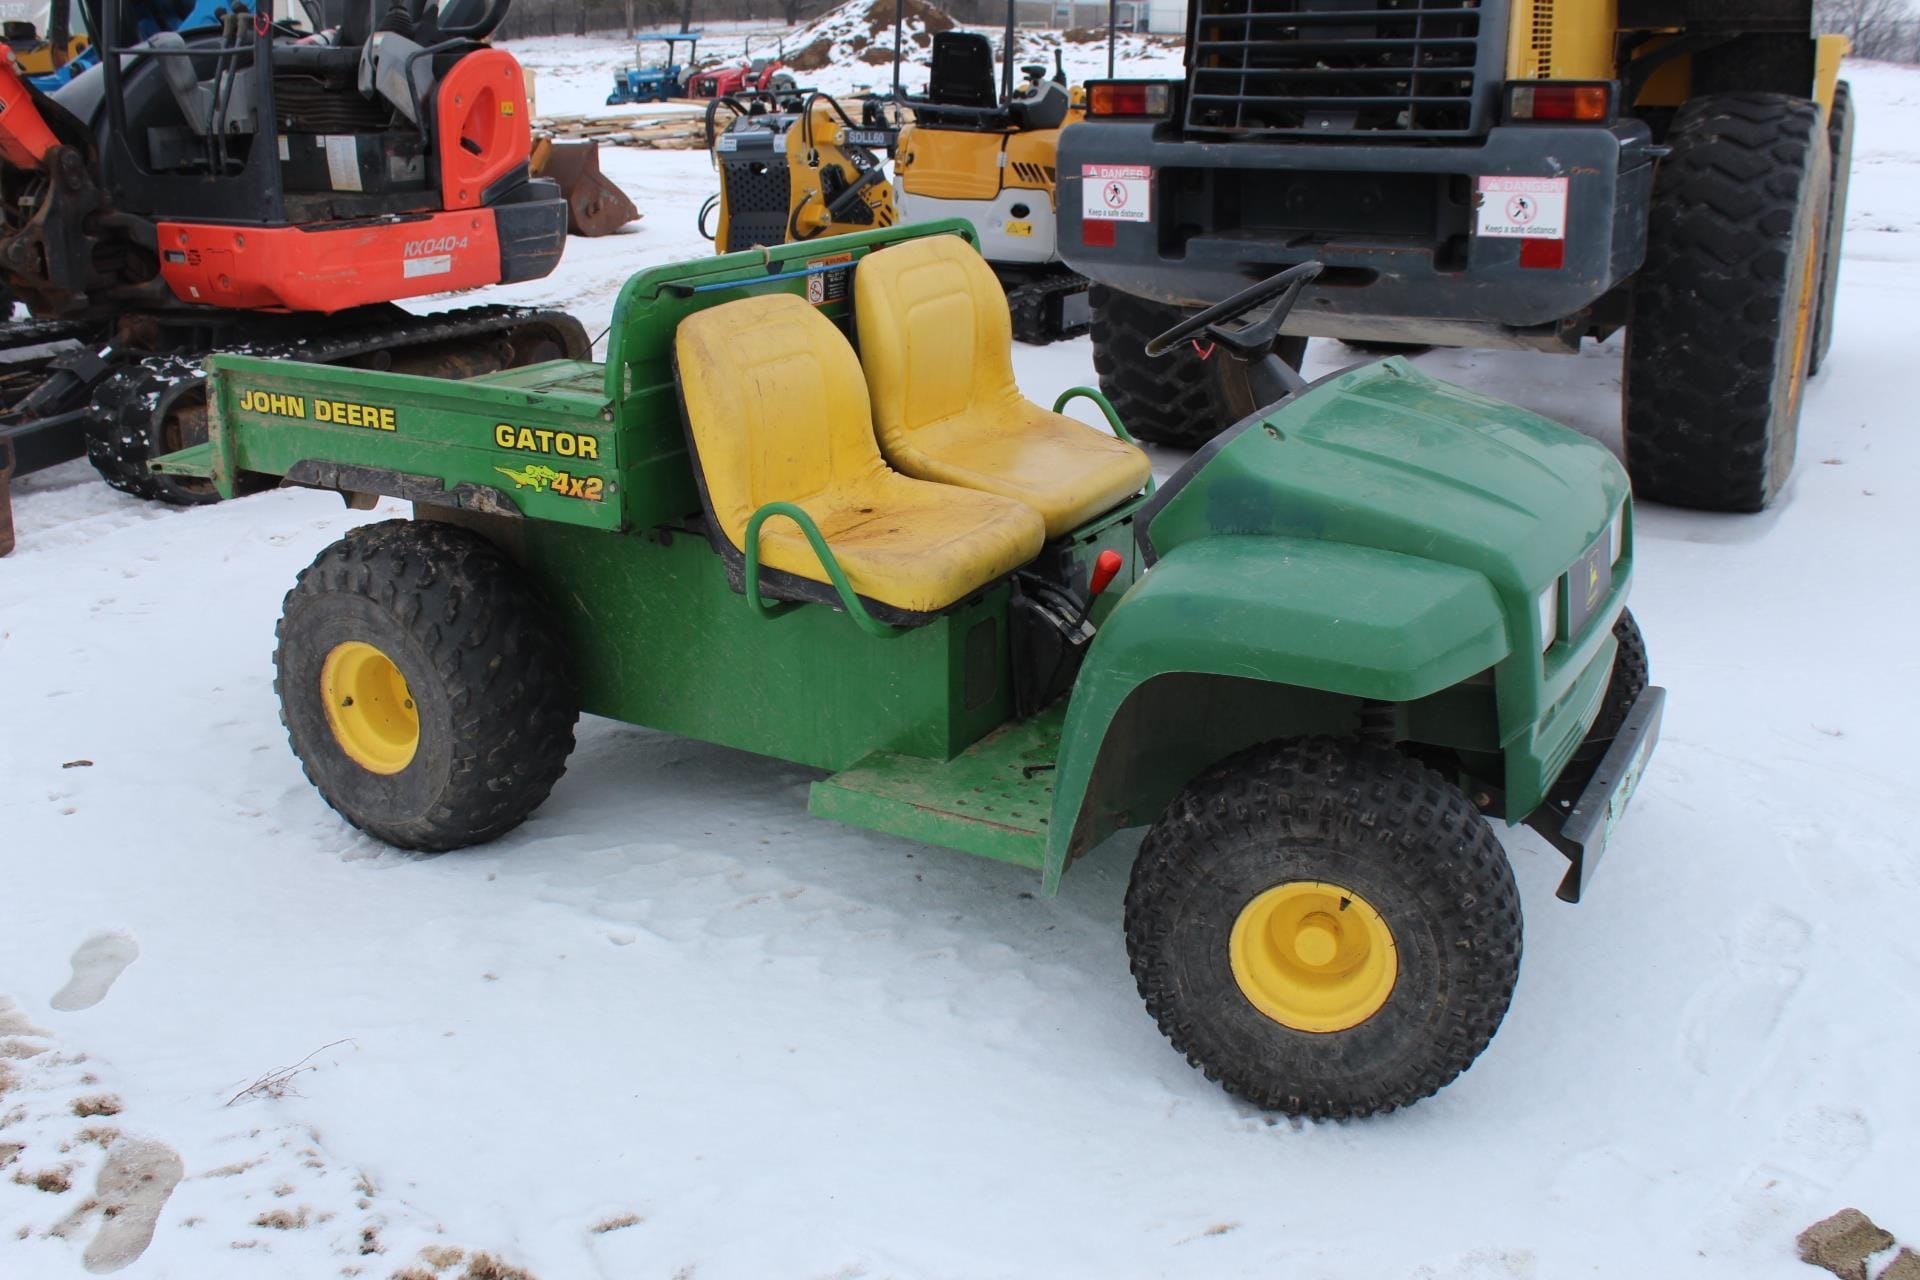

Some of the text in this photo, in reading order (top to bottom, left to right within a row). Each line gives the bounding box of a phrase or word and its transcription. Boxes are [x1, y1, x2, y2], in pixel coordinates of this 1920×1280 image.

[849, 132, 884, 144] SDLL60
[1100, 168, 1144, 178] DANGER
[1504, 181, 1564, 192] DANGER
[1088, 208, 1102, 217] Keep
[1108, 208, 1119, 217] safe
[1120, 208, 1144, 218] distance
[1485, 224, 1503, 233] Keep
[1510, 225, 1525, 234] safe
[1526, 225, 1557, 235] distance
[404, 235, 468, 257] KX040-4
[240, 389, 397, 432] JOHN DEERE
[494, 423, 599, 460] GATOR
[551, 471, 604, 501] 4x2
